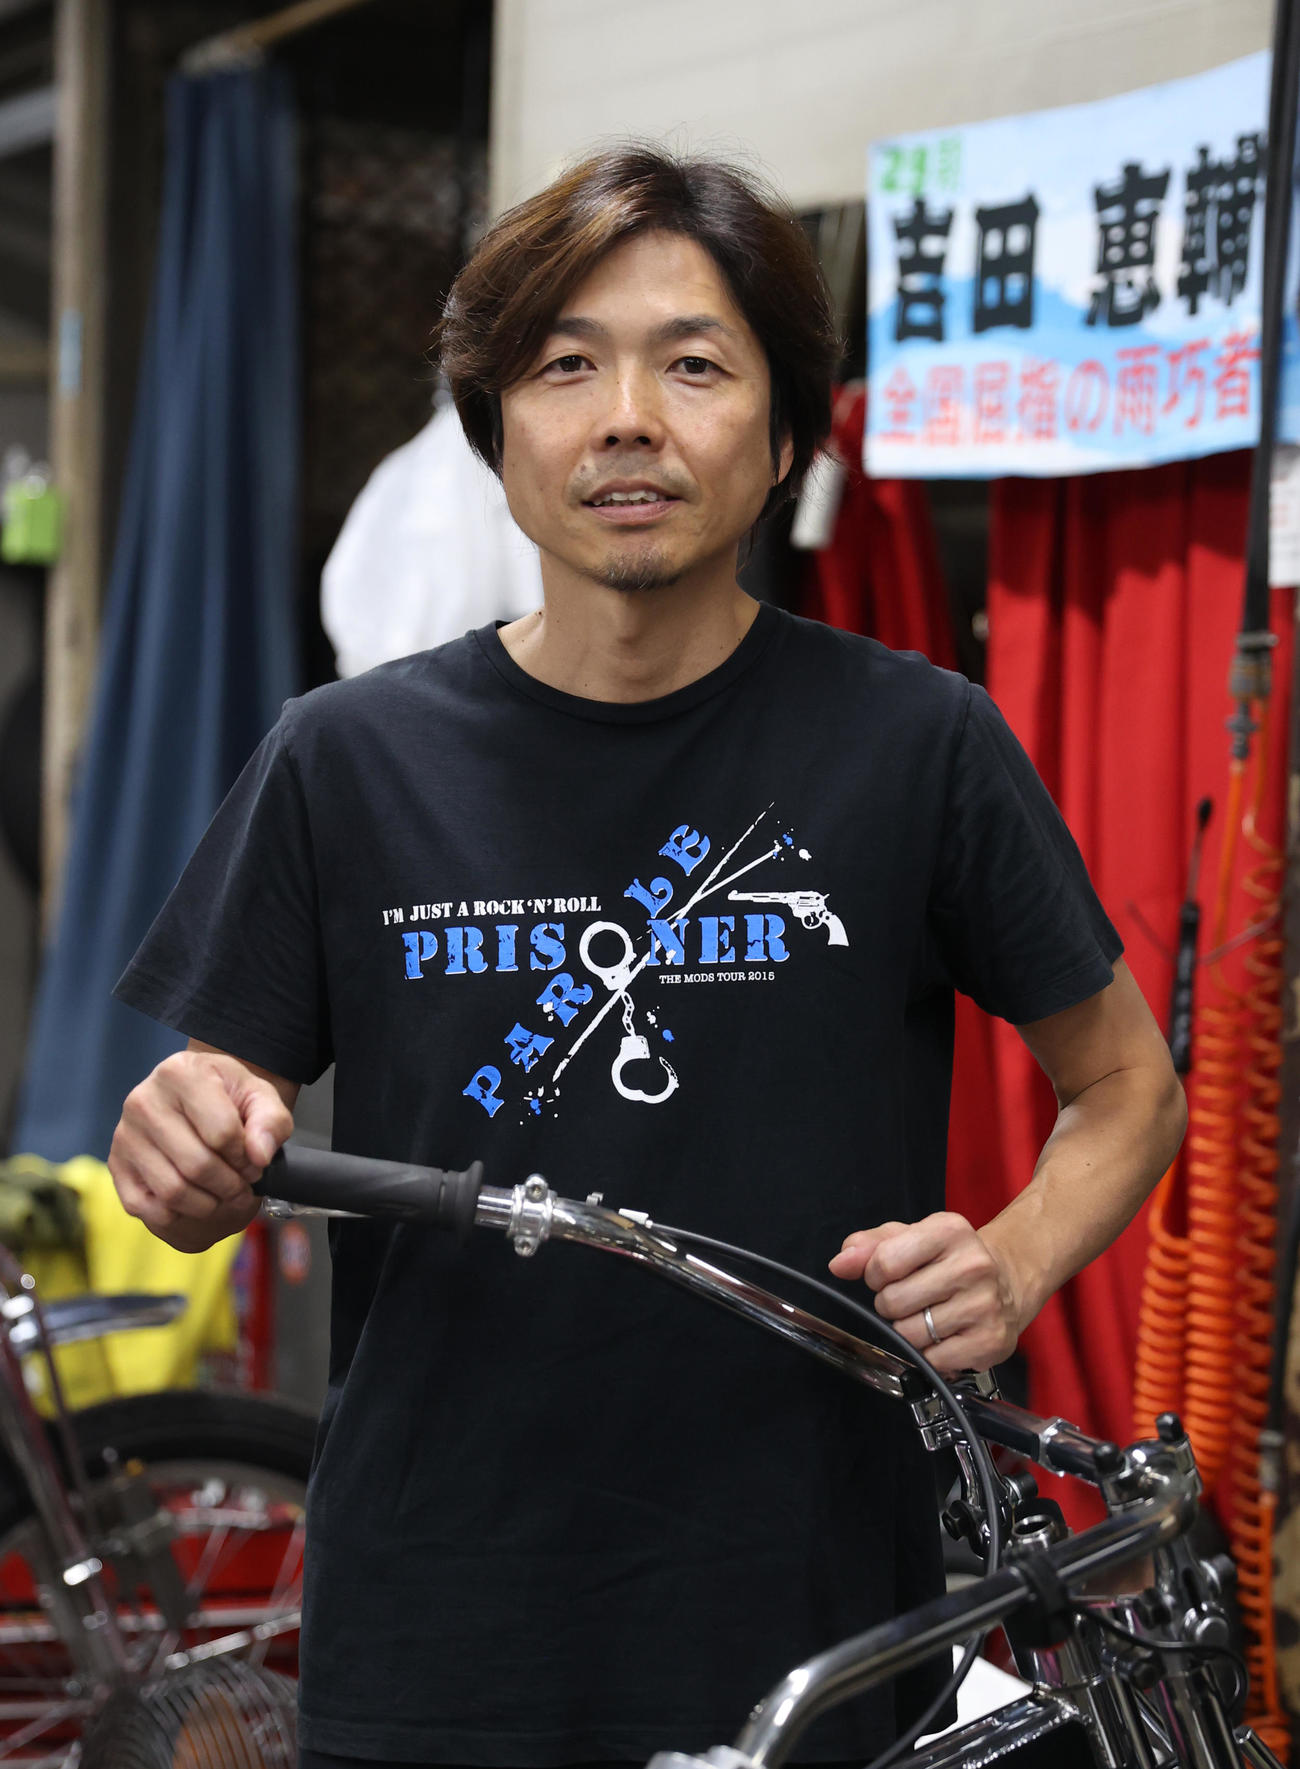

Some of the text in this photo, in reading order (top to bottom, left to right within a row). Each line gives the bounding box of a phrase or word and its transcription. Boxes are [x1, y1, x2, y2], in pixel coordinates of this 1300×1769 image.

[893, 192, 1041, 341] 吉田
[382, 907, 404, 926] I'M
[409, 902, 453, 922] JUST
[456, 901, 470, 917] A
[659, 971, 775, 984] THE MODS TOUR 2015
